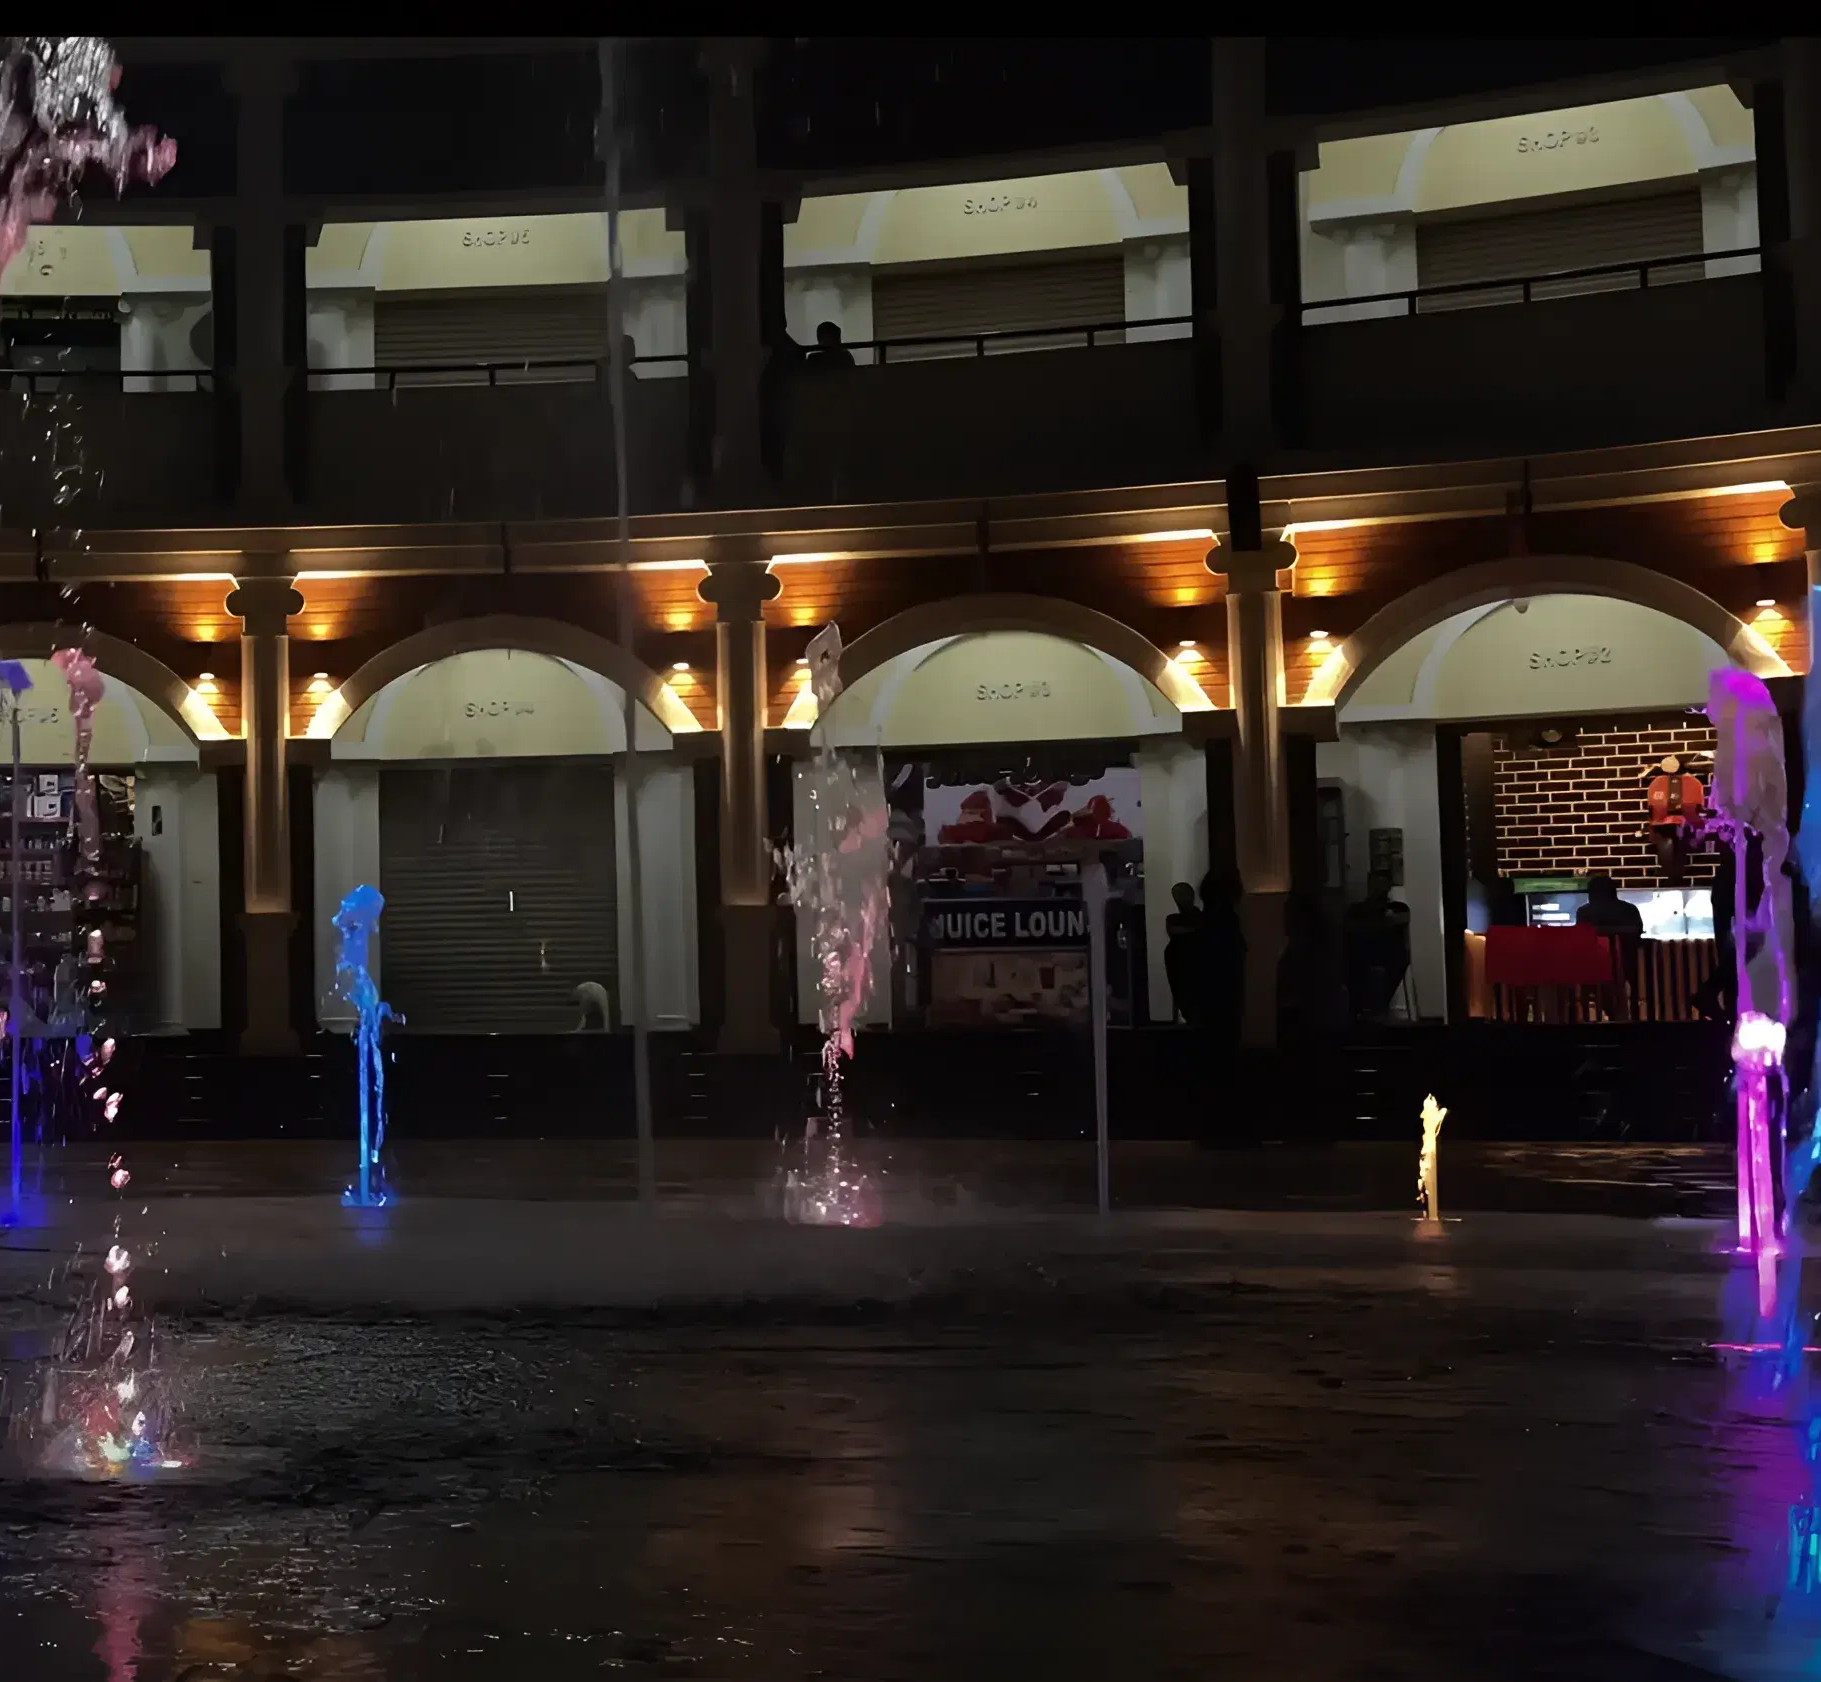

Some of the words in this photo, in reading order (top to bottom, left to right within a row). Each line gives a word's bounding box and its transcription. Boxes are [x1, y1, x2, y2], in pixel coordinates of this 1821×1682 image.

[1517, 131, 1571, 153] SHOP
[1528, 648, 1583, 670] SHOP
[977, 683, 1023, 701] SHOP
[930, 911, 1008, 940] JUICE
[1015, 910, 1088, 938] LOUN
